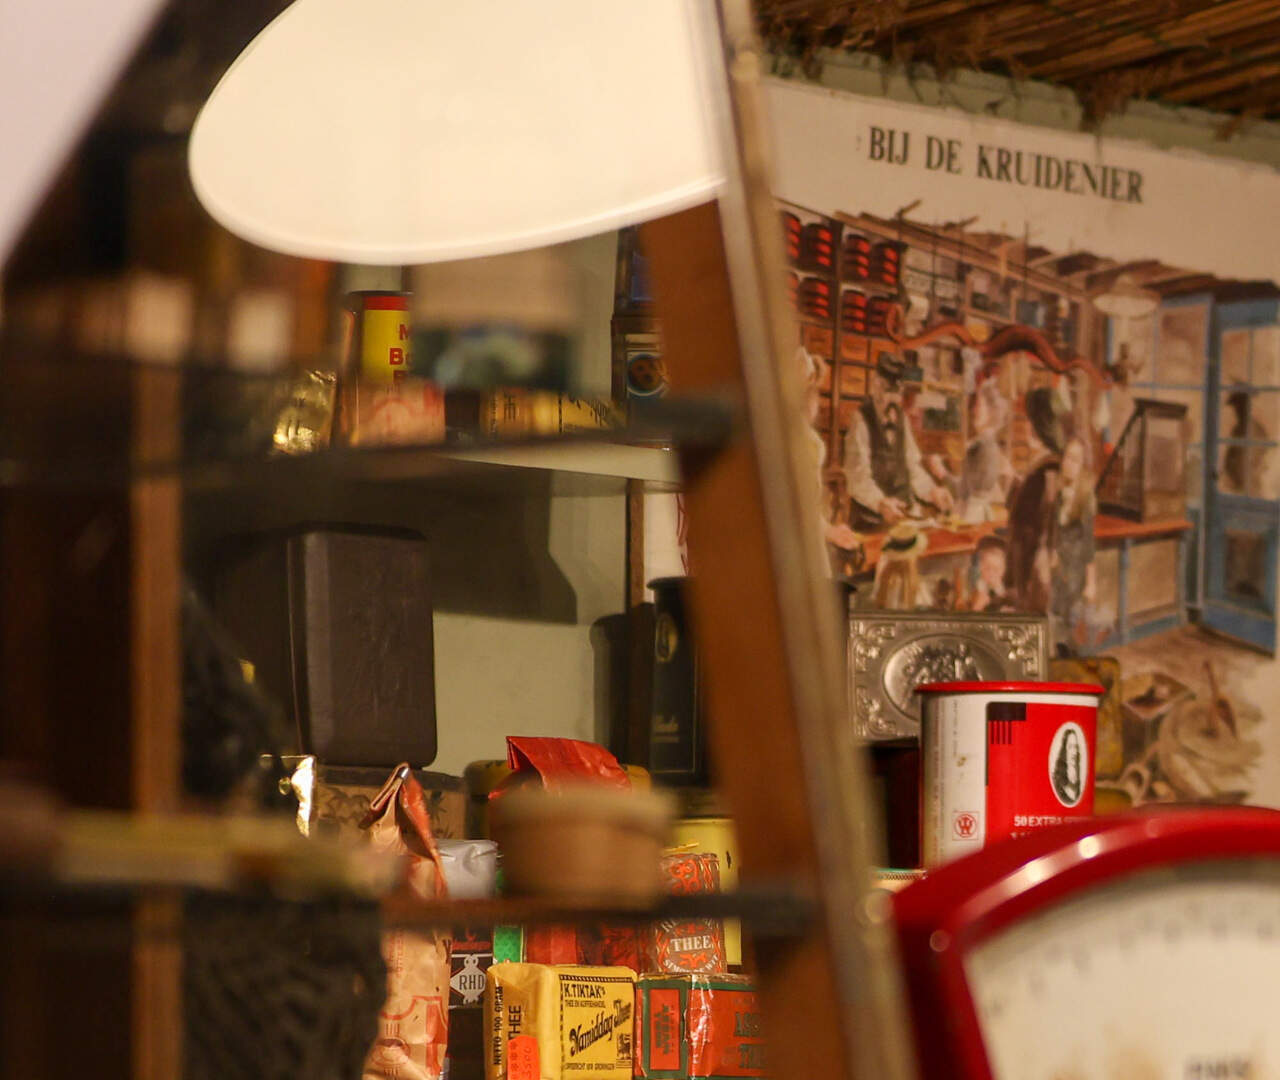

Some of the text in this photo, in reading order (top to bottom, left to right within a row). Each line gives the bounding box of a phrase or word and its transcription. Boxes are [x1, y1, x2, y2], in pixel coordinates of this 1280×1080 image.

[868, 126, 1145, 204] BIJ DE KRUIDENIER
[670, 935, 712, 952] THEE
[508, 1004, 521, 1040] THEE
